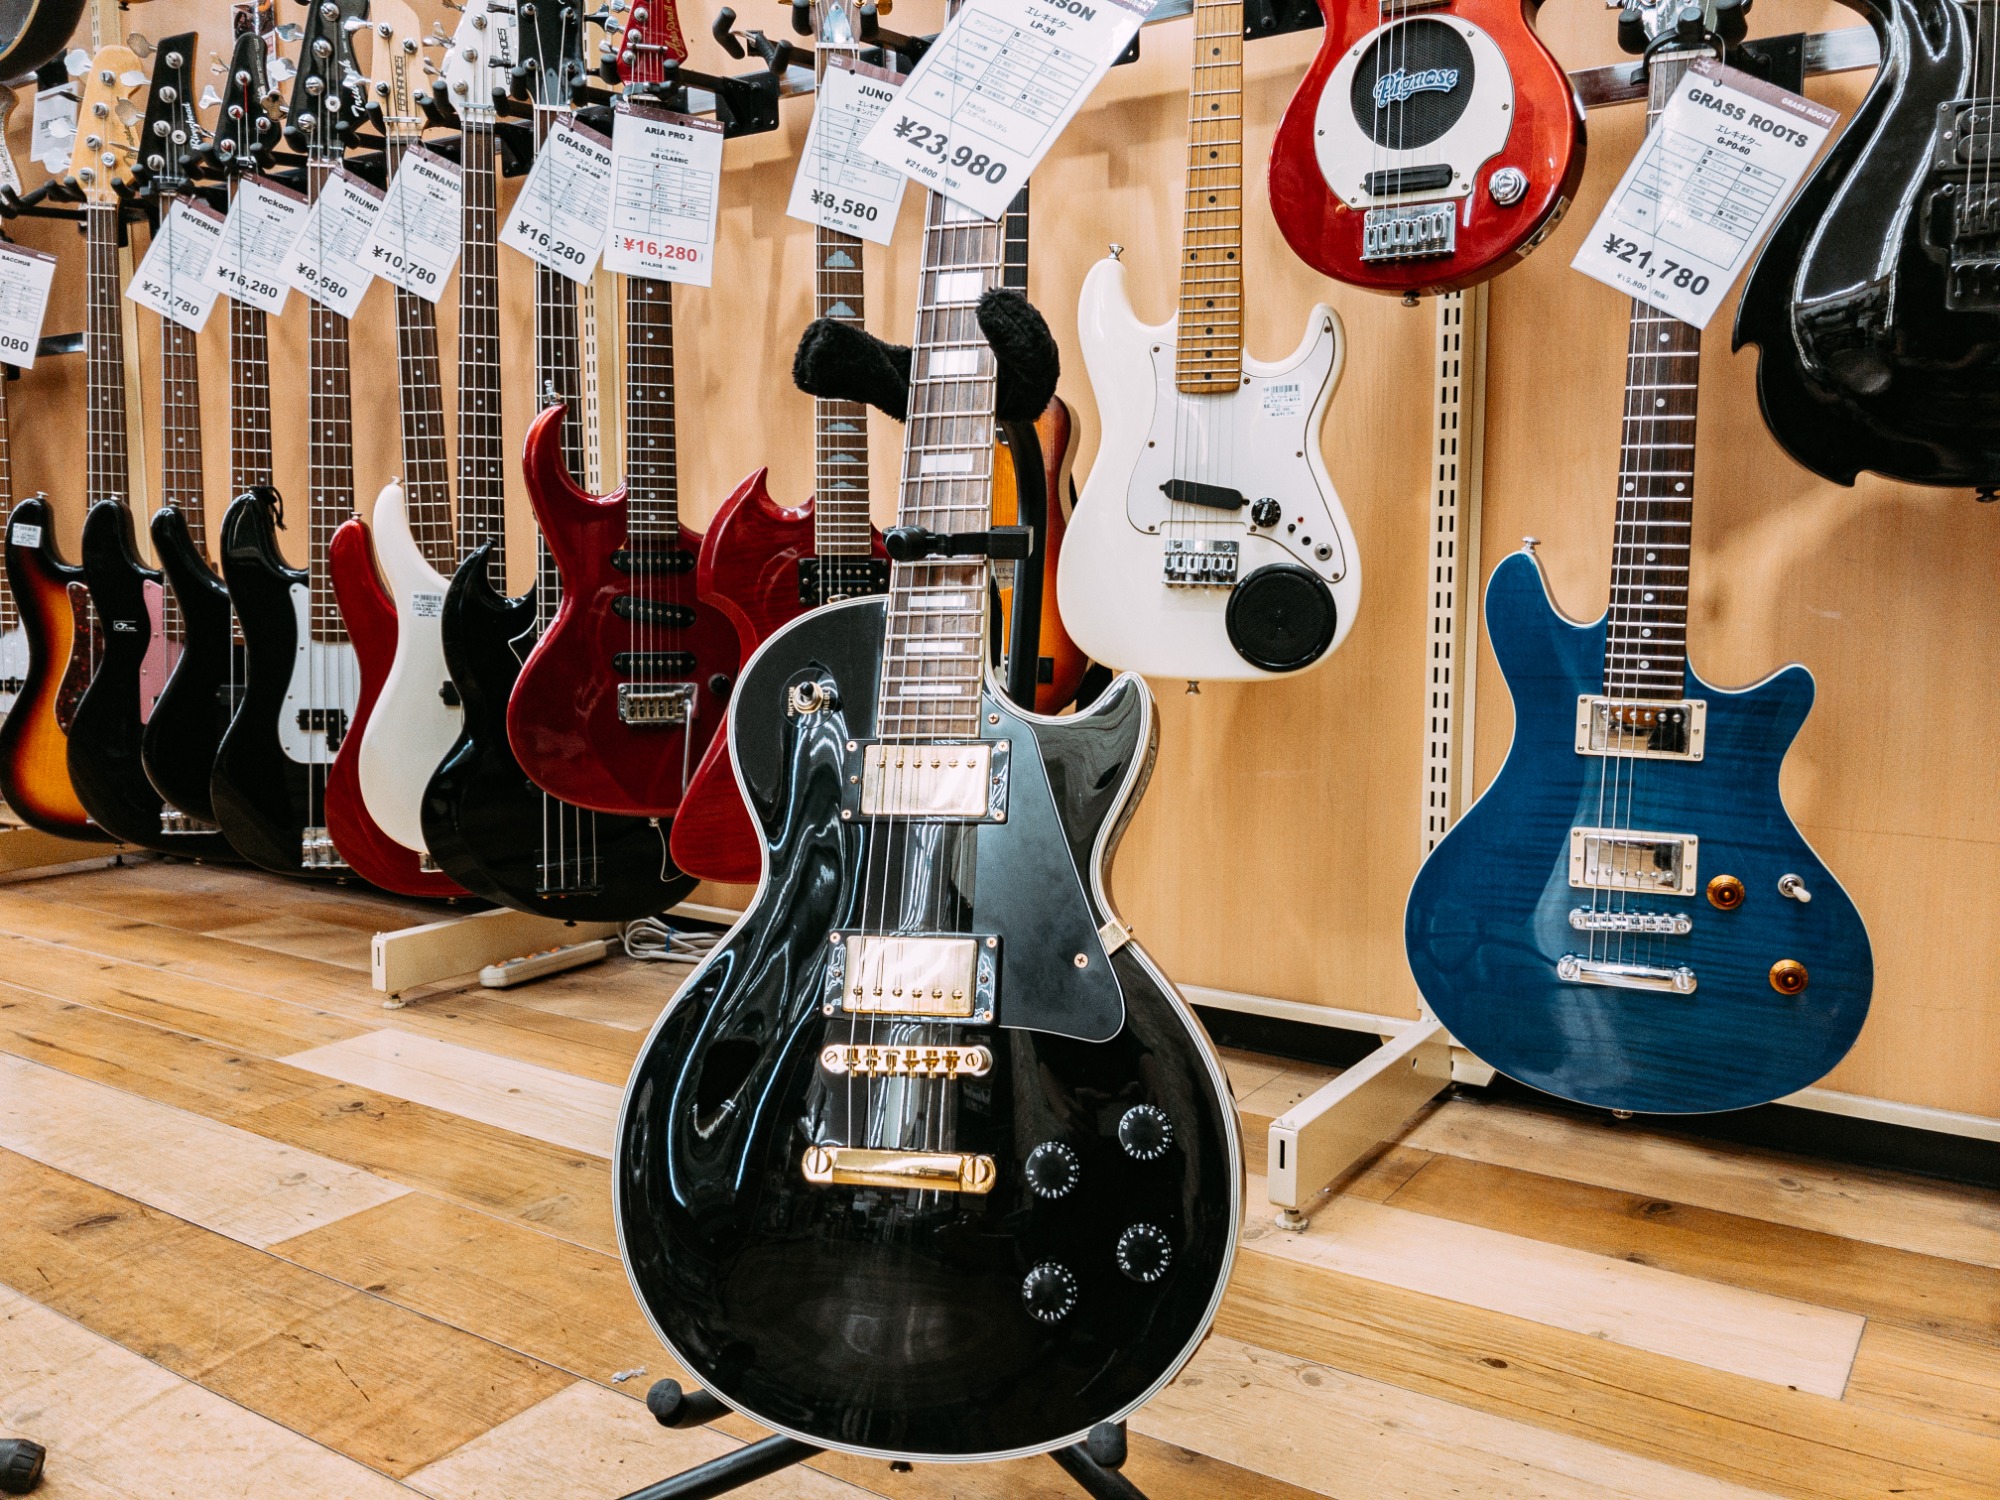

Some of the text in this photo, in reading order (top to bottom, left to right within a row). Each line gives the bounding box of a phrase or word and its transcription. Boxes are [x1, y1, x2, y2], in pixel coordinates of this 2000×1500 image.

[1025, 6, 1073, 31] エレキギター
[1030, 20, 1056, 36] LP-38
[858, 85, 893, 102] JUNO
[1373, 68, 1458, 108] Pignose
[1688, 88, 1809, 148] GRASS ROOTS
[1781, 98, 1832, 124] GRASS ROOTS
[557, 133, 593, 156] GRASS
[645, 126, 665, 136] ARIA
[668, 131, 685, 139] PRO
[1715, 124, 1763, 147] エレキギター
[661, 154, 688, 164] CLASSIC
[894, 116, 1007, 184] ¥23,980
[413, 164, 461, 193] FERNAND
[905, 158, 938, 178] ¥21,800
[258, 195, 295, 214] rockoon
[344, 189, 379, 212] TRIUMP
[811, 189, 878, 221] ¥8,580
[181, 211, 220, 236] RIVERHE
[517, 220, 585, 265] ¥16,280
[623, 238, 697, 262] ¥16,280
[2, 255, 30, 267] BACCHUS
[372, 245, 436, 284] ¥10,780
[1603, 233, 1710, 296] ¥21,780
[217, 266, 278, 298] ¥16,280
[297, 262, 348, 298] ¥8,580
[142, 281, 199, 316] ¥21,780
